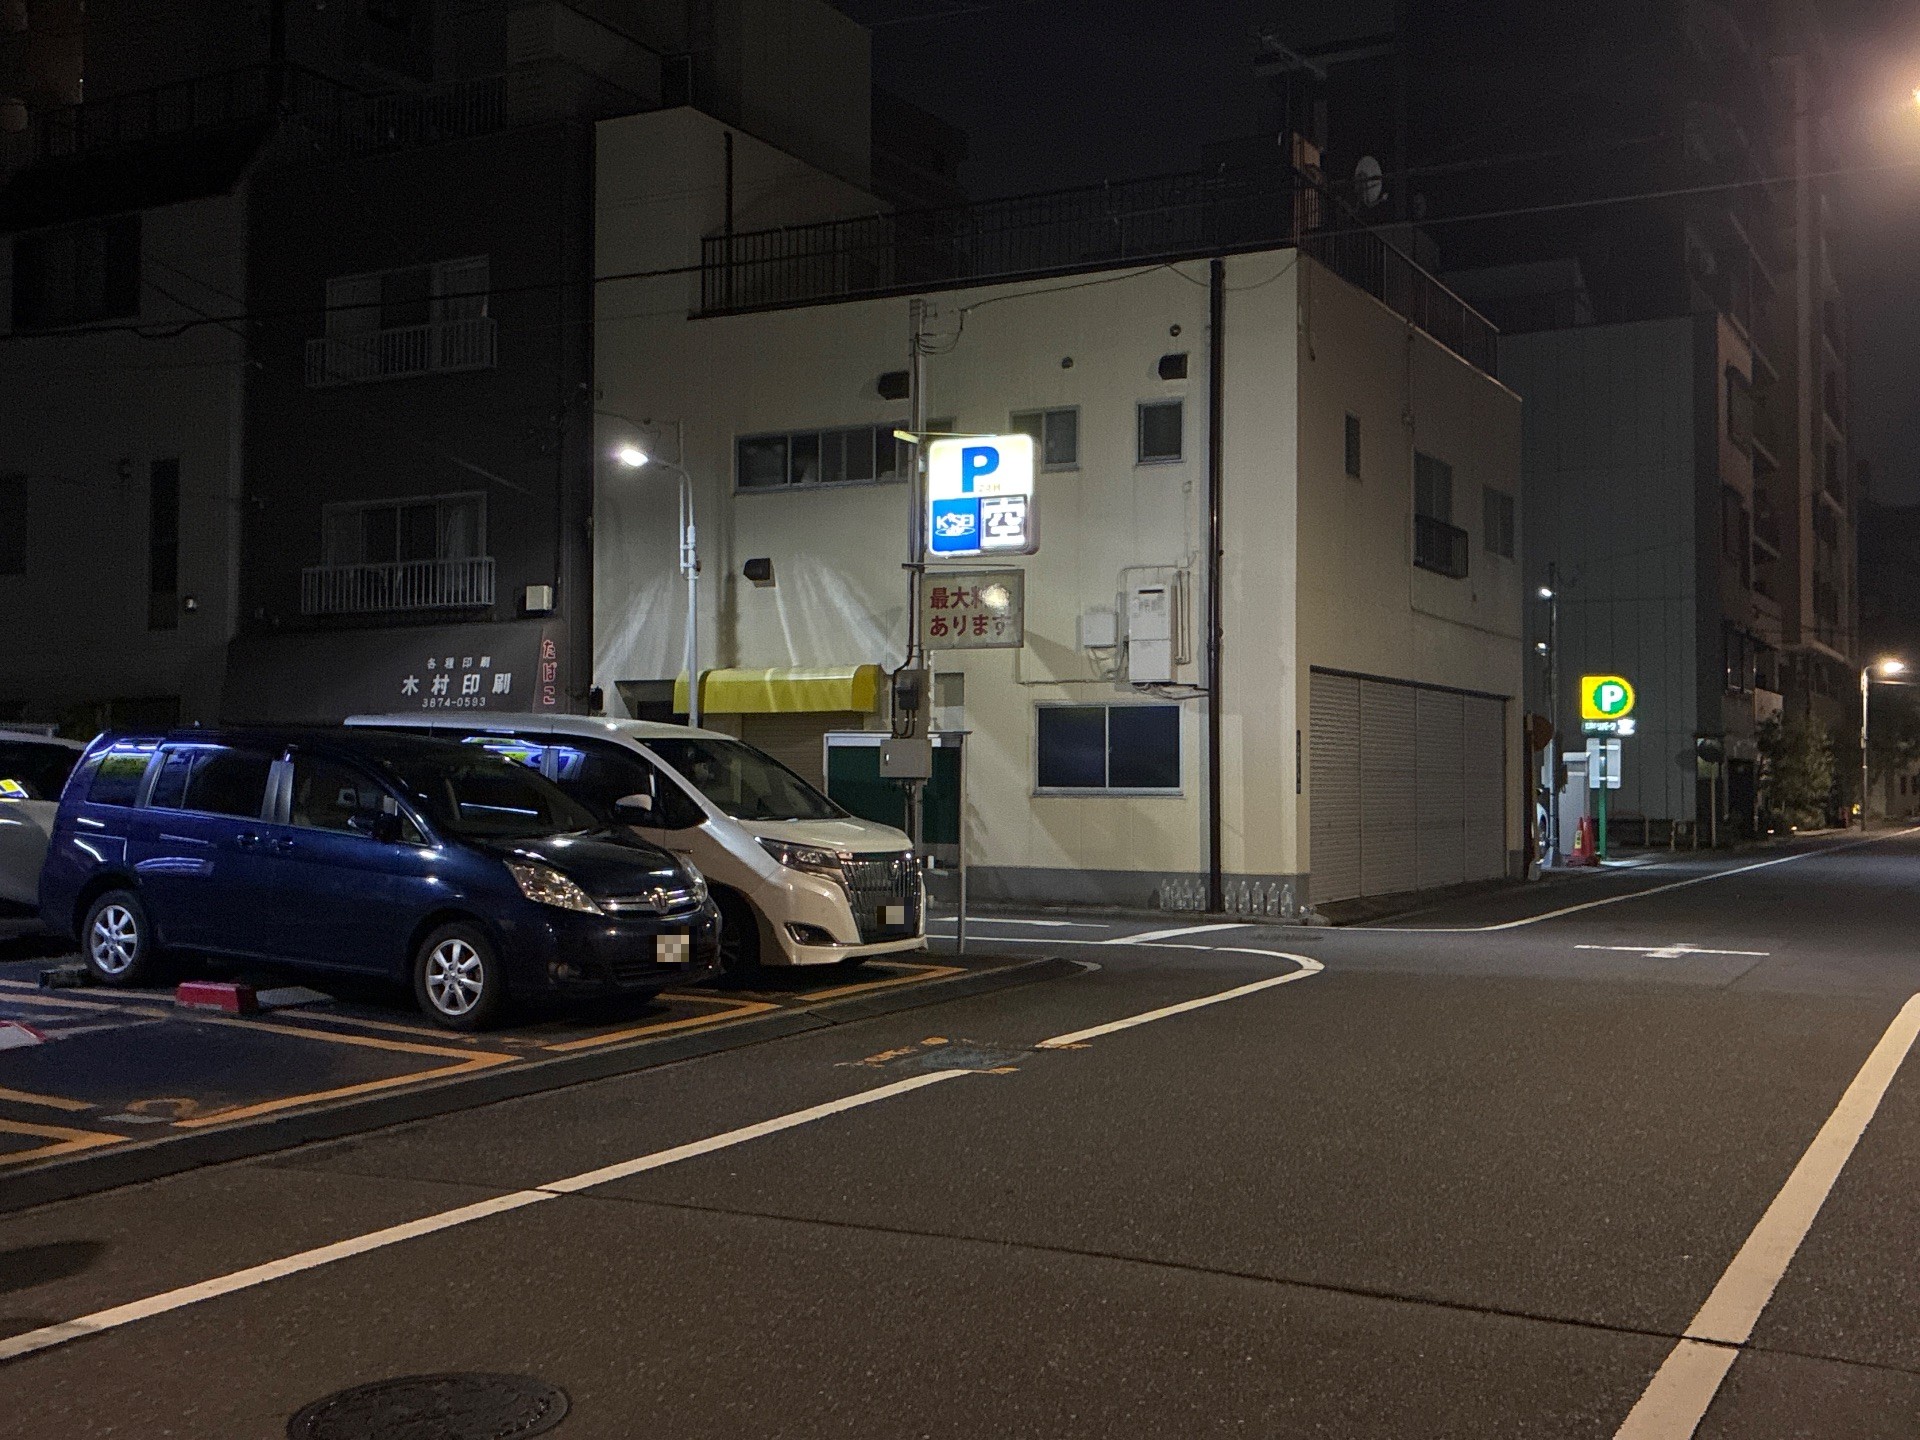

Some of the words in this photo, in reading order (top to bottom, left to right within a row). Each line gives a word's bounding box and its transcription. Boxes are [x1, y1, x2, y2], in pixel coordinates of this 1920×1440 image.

[962, 446, 999, 493] P
[983, 498, 1024, 547] 空
[930, 614, 1011, 636] あります
[401, 673, 511, 696] 木村印刷
[1602, 685, 1624, 712] P
